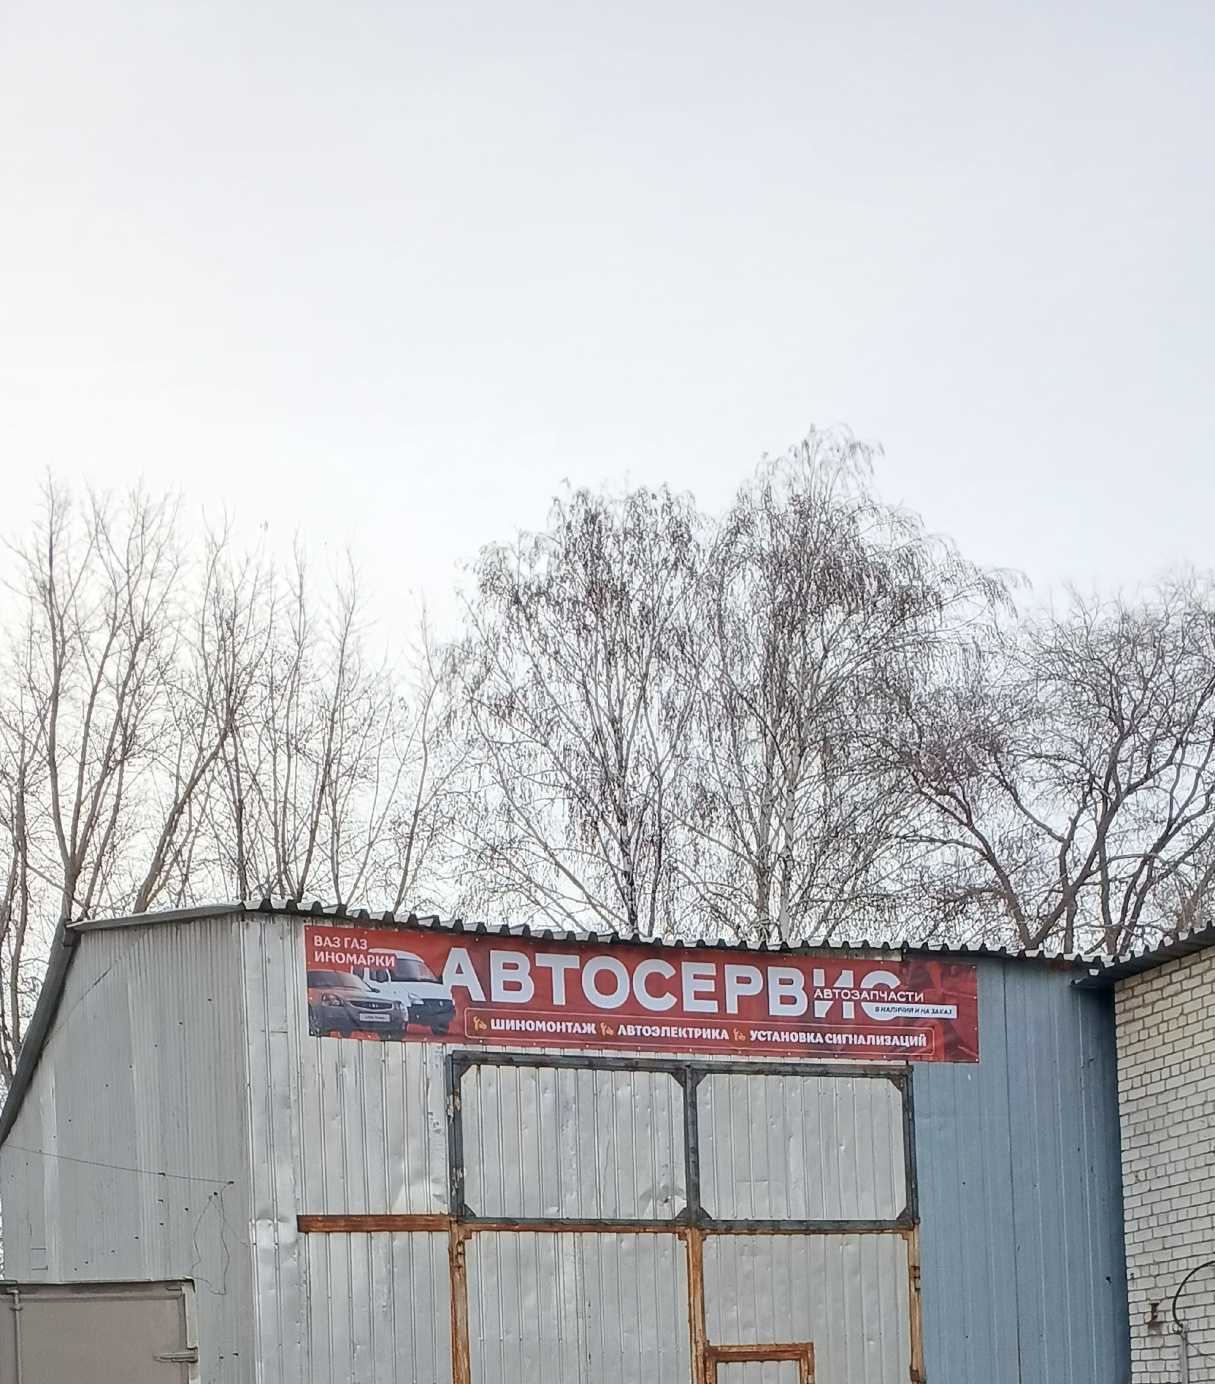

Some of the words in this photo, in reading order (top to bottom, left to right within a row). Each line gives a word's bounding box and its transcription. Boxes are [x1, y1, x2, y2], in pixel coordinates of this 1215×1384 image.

[314, 935, 340, 948] ВАЗ
[344, 937, 367, 950] ГАЗ
[314, 950, 395, 967] ИНОМАРКИ
[442, 947, 903, 1021] АВТОСЕРВИС
[813, 988, 924, 1003] АВТОЗАПЧАСТИ
[490, 1017, 596, 1035] ШИНОМОНТАЖ
[617, 1023, 729, 1041] АВТОЭЛЕКТРИКА
[749, 1028, 824, 1045] УСТАНОВКА
[824, 1031, 927, 1047] СИГНАЛИЗАЦИЙ
